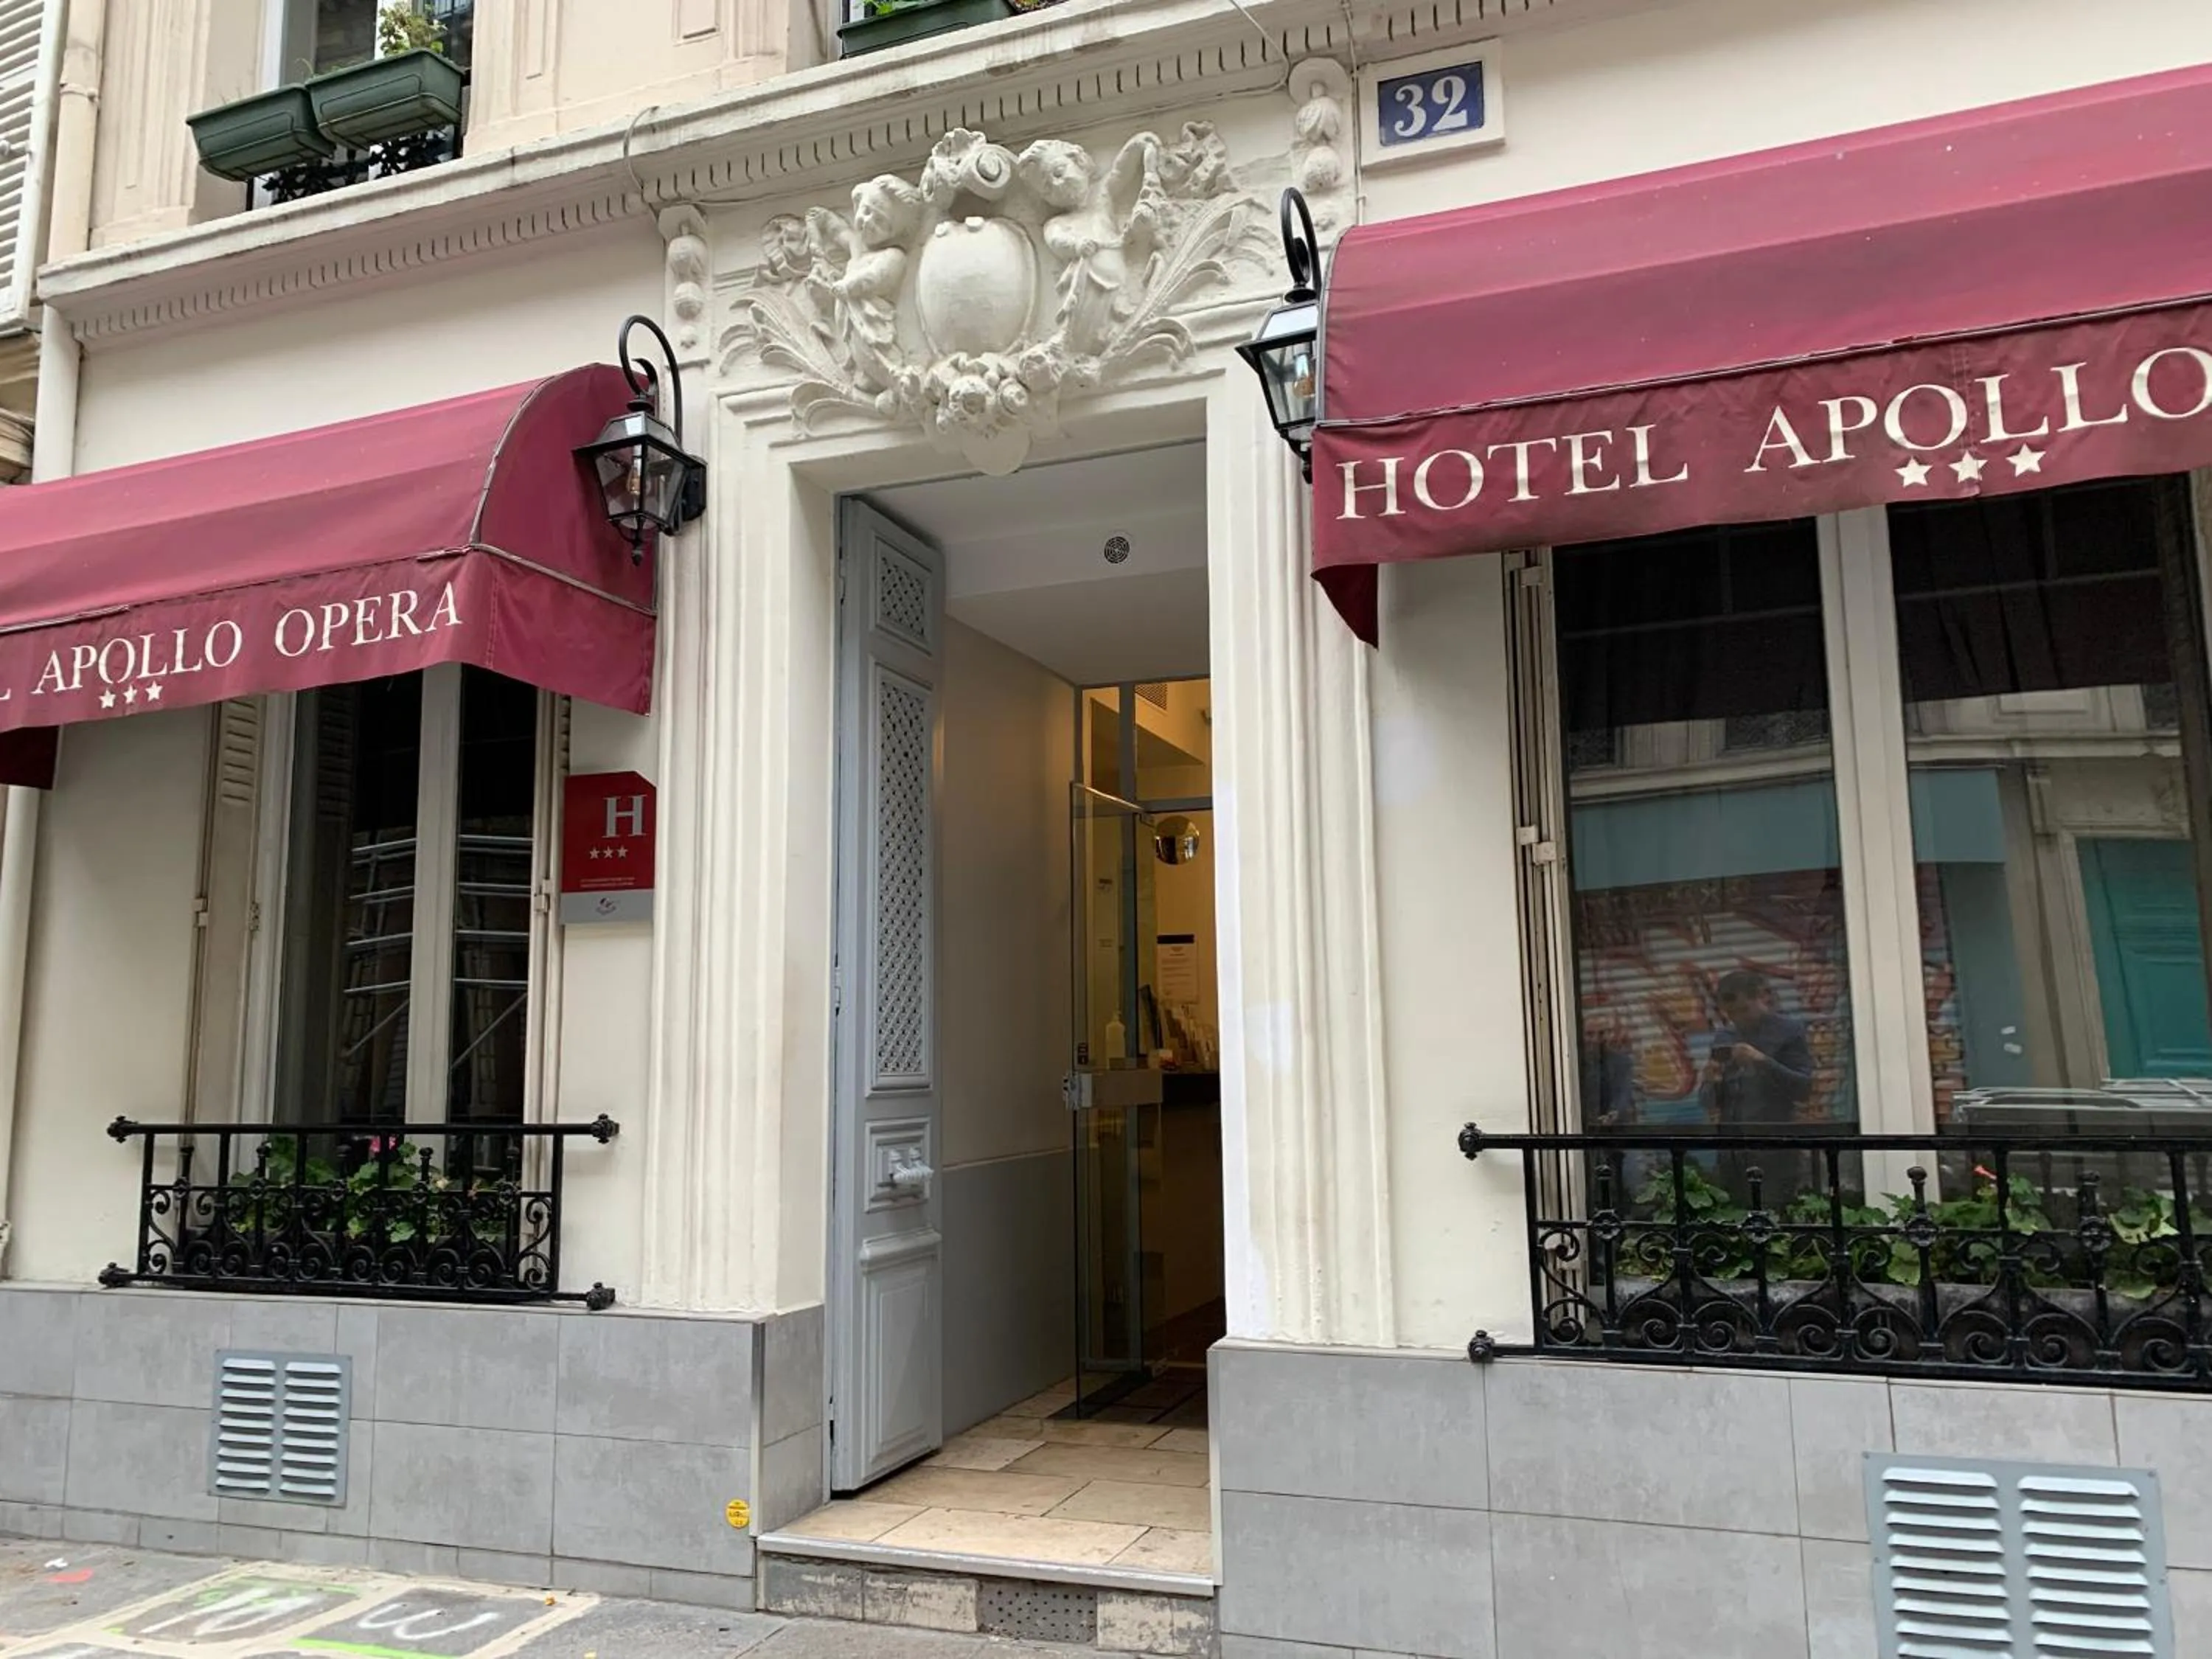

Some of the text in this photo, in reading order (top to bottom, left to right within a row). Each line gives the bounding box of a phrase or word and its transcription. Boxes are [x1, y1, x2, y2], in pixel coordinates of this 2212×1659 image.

[1394, 75, 1468, 136] 32
[1335, 347, 2212, 520] HOTEL APOLLO
[30, 581, 462, 695] APOLLO OPERA
[601, 794, 647, 838] H
